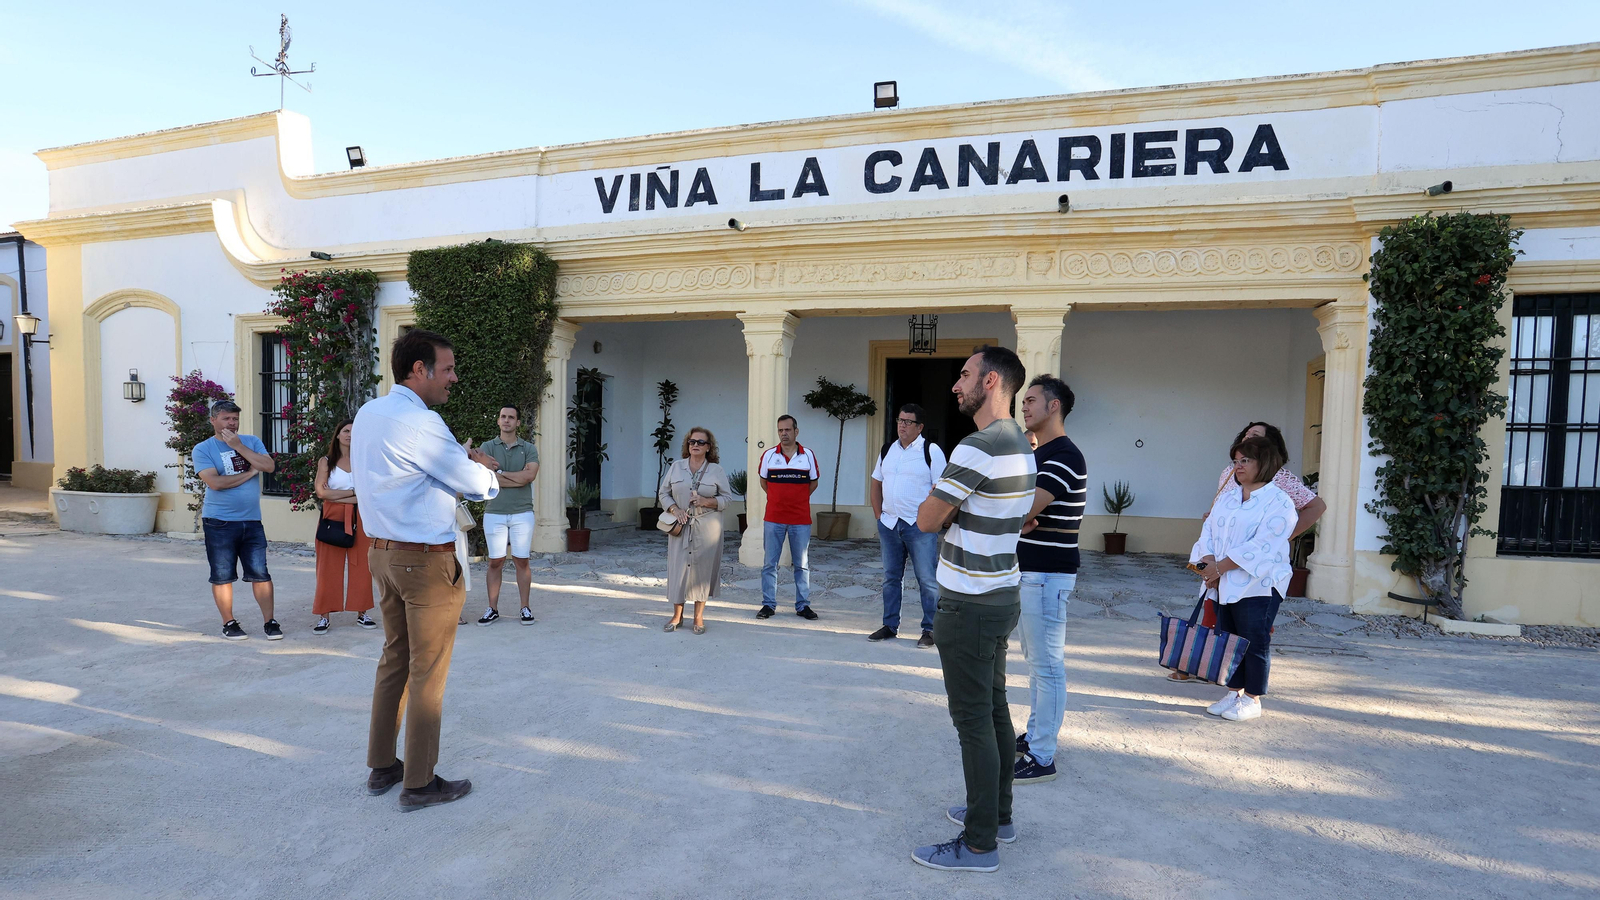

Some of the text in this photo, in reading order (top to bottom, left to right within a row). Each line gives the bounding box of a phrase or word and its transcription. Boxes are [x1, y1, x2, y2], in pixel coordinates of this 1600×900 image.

[251, 66, 256, 76] O
[311, 62, 317, 72] E
[594, 124, 1290, 214] VIÑA LA CANARIERA
